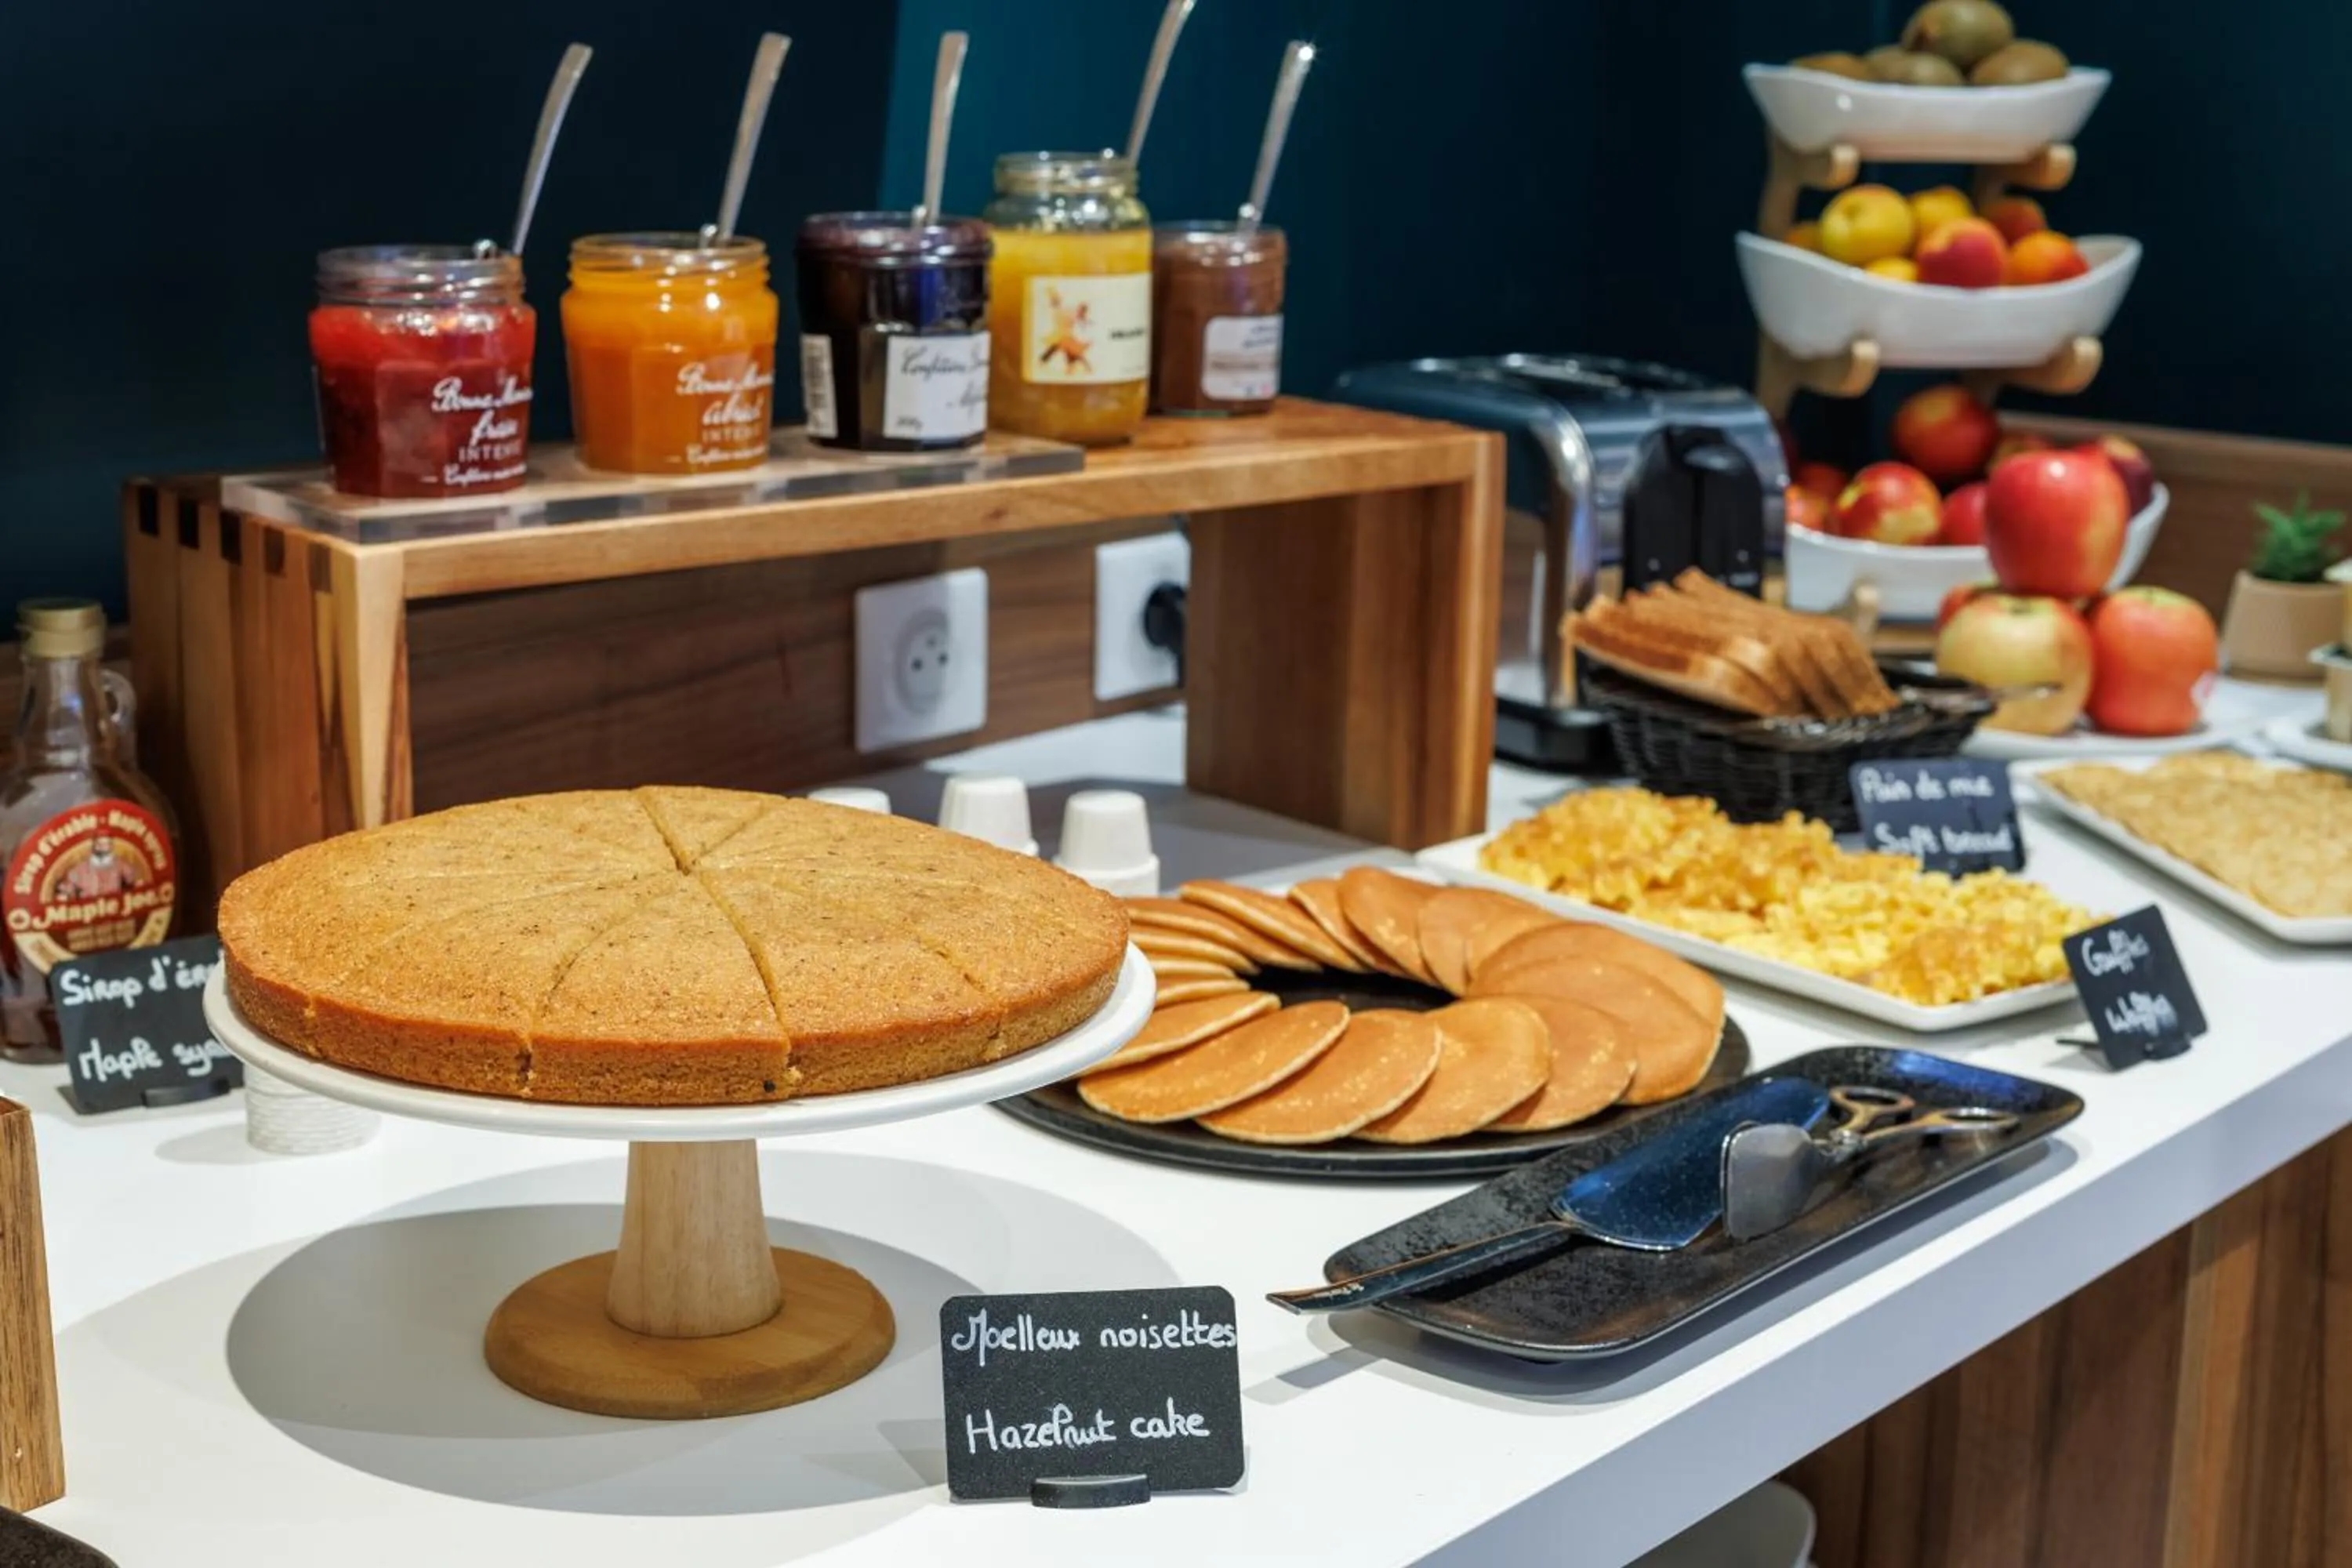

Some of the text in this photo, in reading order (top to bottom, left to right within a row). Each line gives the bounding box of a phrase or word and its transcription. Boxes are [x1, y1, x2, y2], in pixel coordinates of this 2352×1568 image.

[32, 898, 118, 930] Maple
[60, 968, 143, 1009] Sirop
[78, 1036, 163, 1083] Maple
[1099, 1309, 1237, 1350] noisettes
[965, 1396, 1211, 1455] Hazelnut cake
